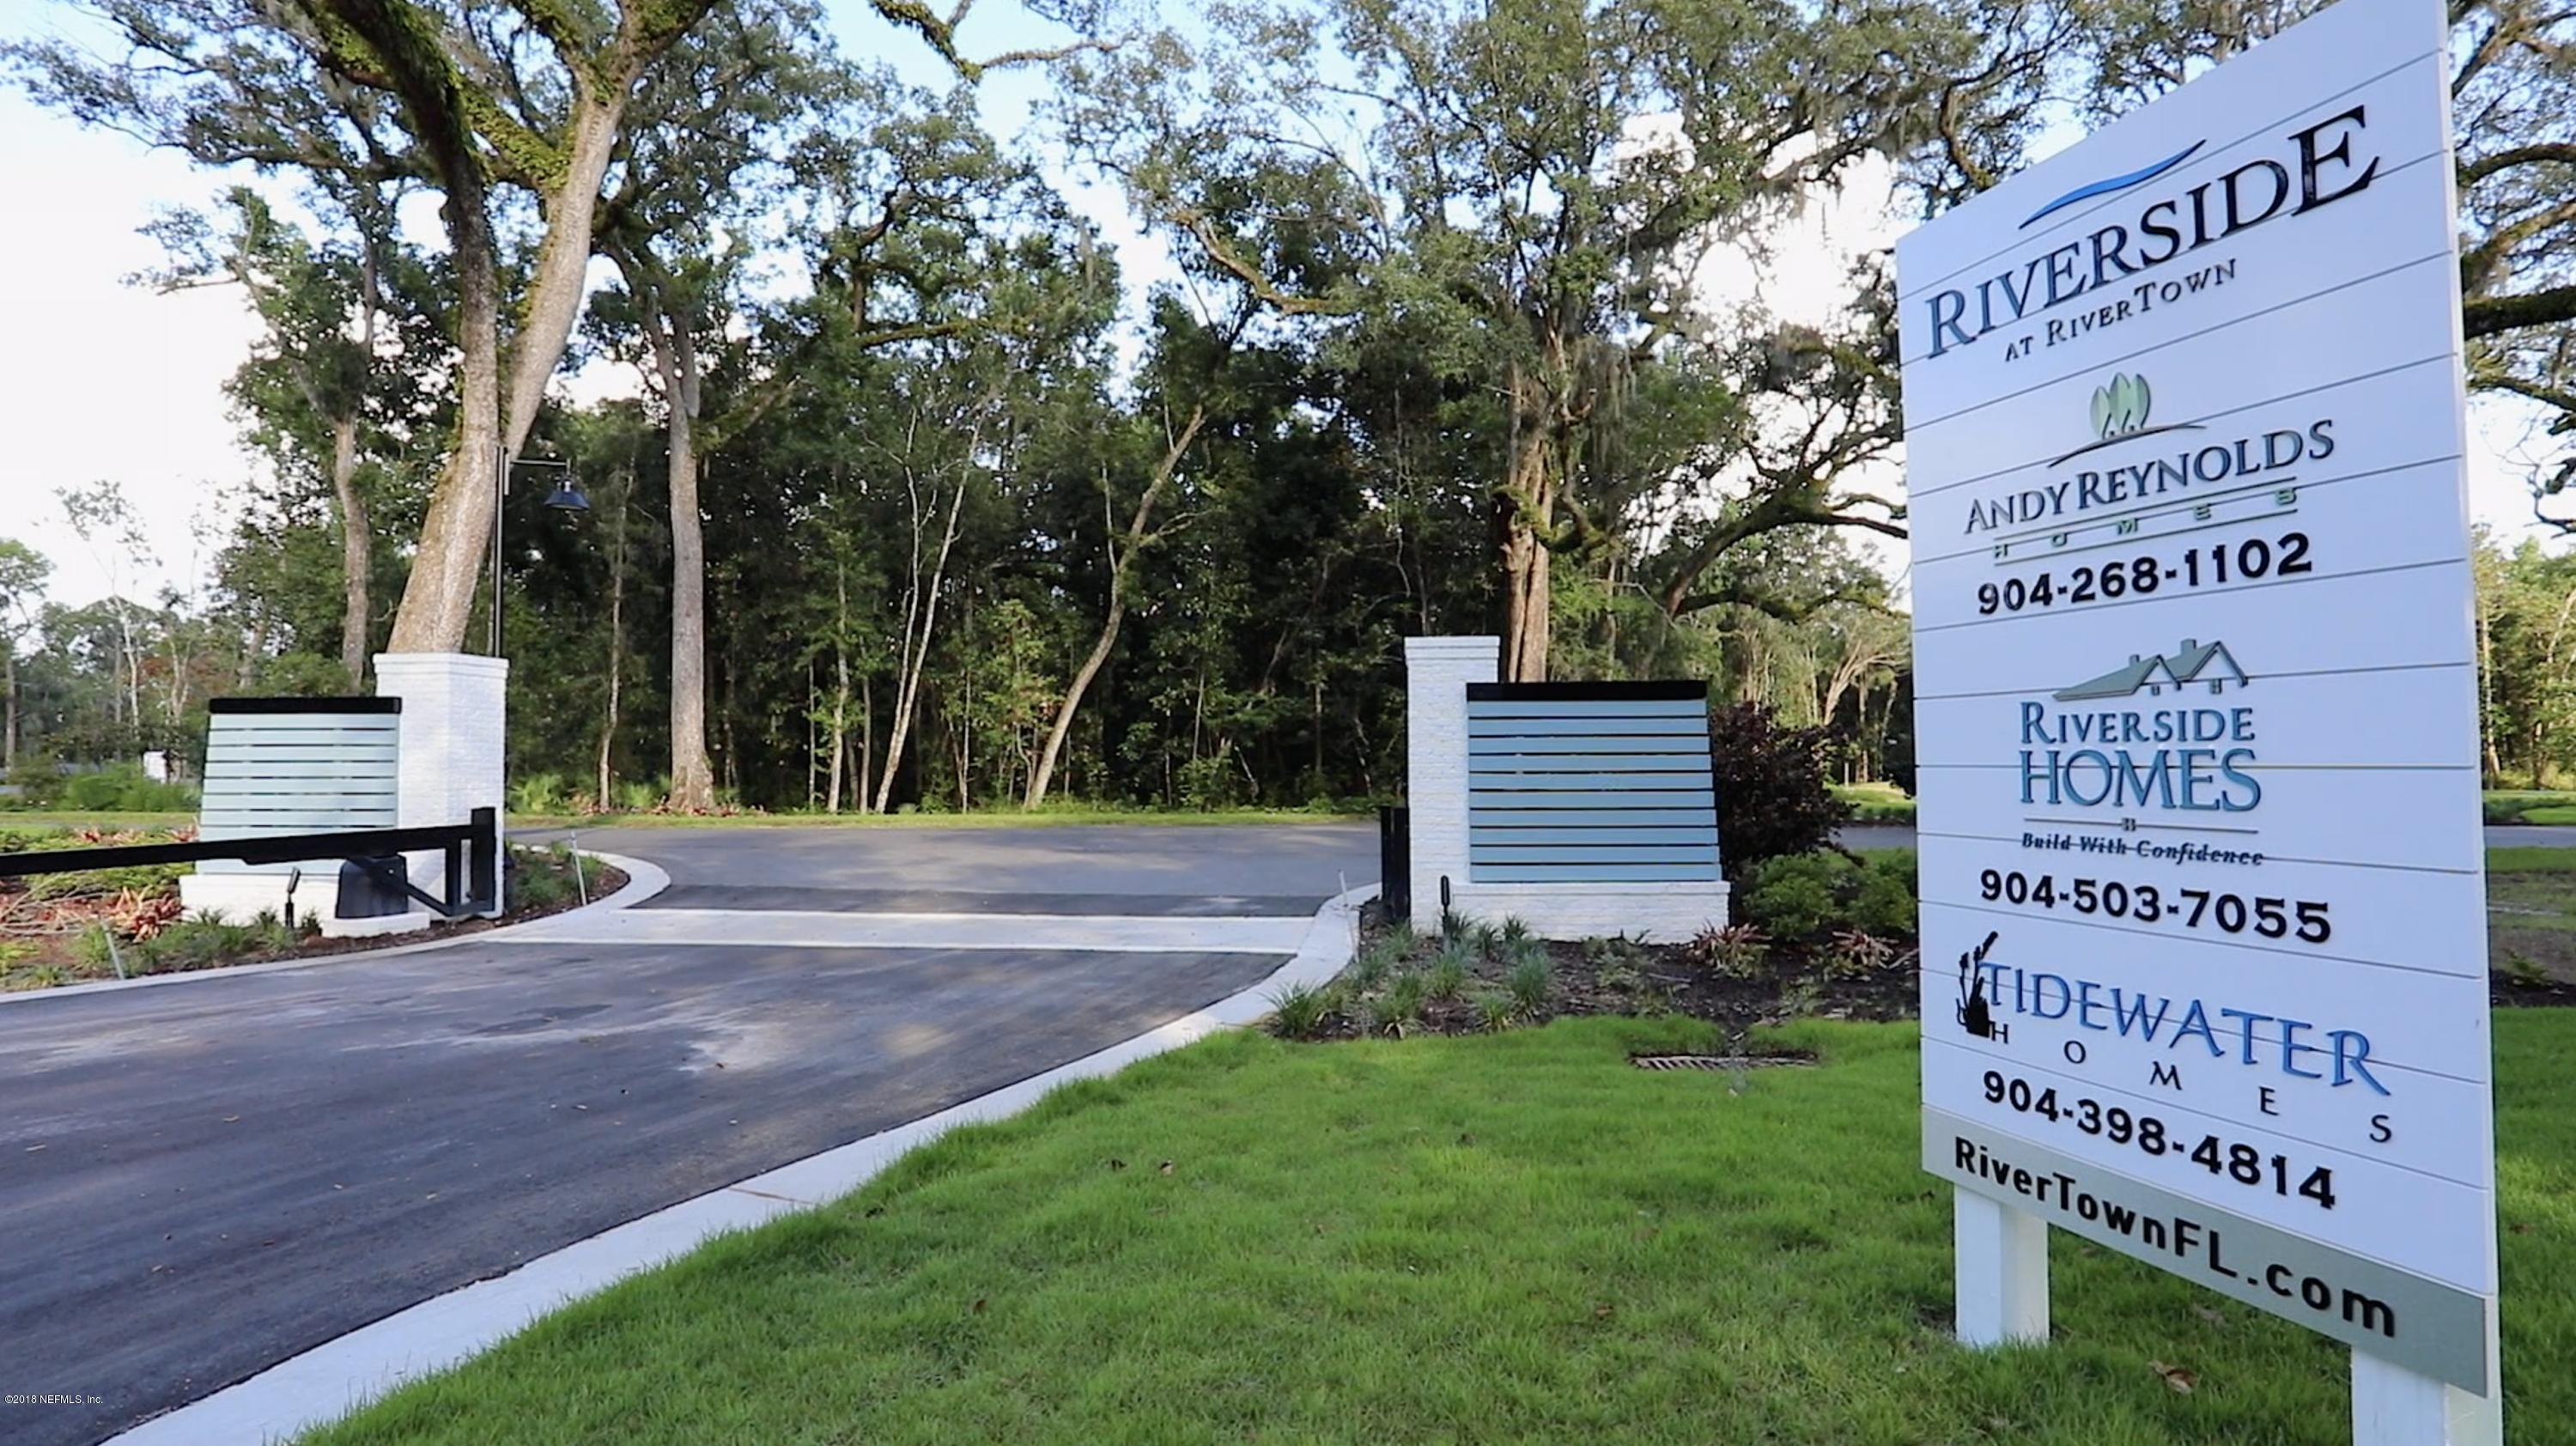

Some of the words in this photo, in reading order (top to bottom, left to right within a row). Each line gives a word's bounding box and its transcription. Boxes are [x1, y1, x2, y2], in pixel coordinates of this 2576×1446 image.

[1925, 105, 2379, 359] RIVERSIDE
[2005, 340, 2034, 362] AT
[1965, 481, 2069, 535] ANDY
[2076, 418, 2335, 510] REYNOLDS
[1994, 486, 2296, 558] HOMES
[1978, 532, 2313, 615] 904-268-1102
[2020, 701, 2256, 744] RIVERSIDE
[2020, 747, 2262, 811] HOMES
[2022, 832, 2070, 852] Build
[2079, 835, 2127, 855] With
[2136, 840, 2264, 866] Confidence
[1980, 868, 2332, 943] 904-503-7055
[1977, 962, 2391, 1096] TIDEWATER
[1990, 1023, 2393, 1143] HOMES
[1983, 1070, 2336, 1209] 904-398-4814
[1955, 1136, 2396, 1338] RiverTownFL.com
